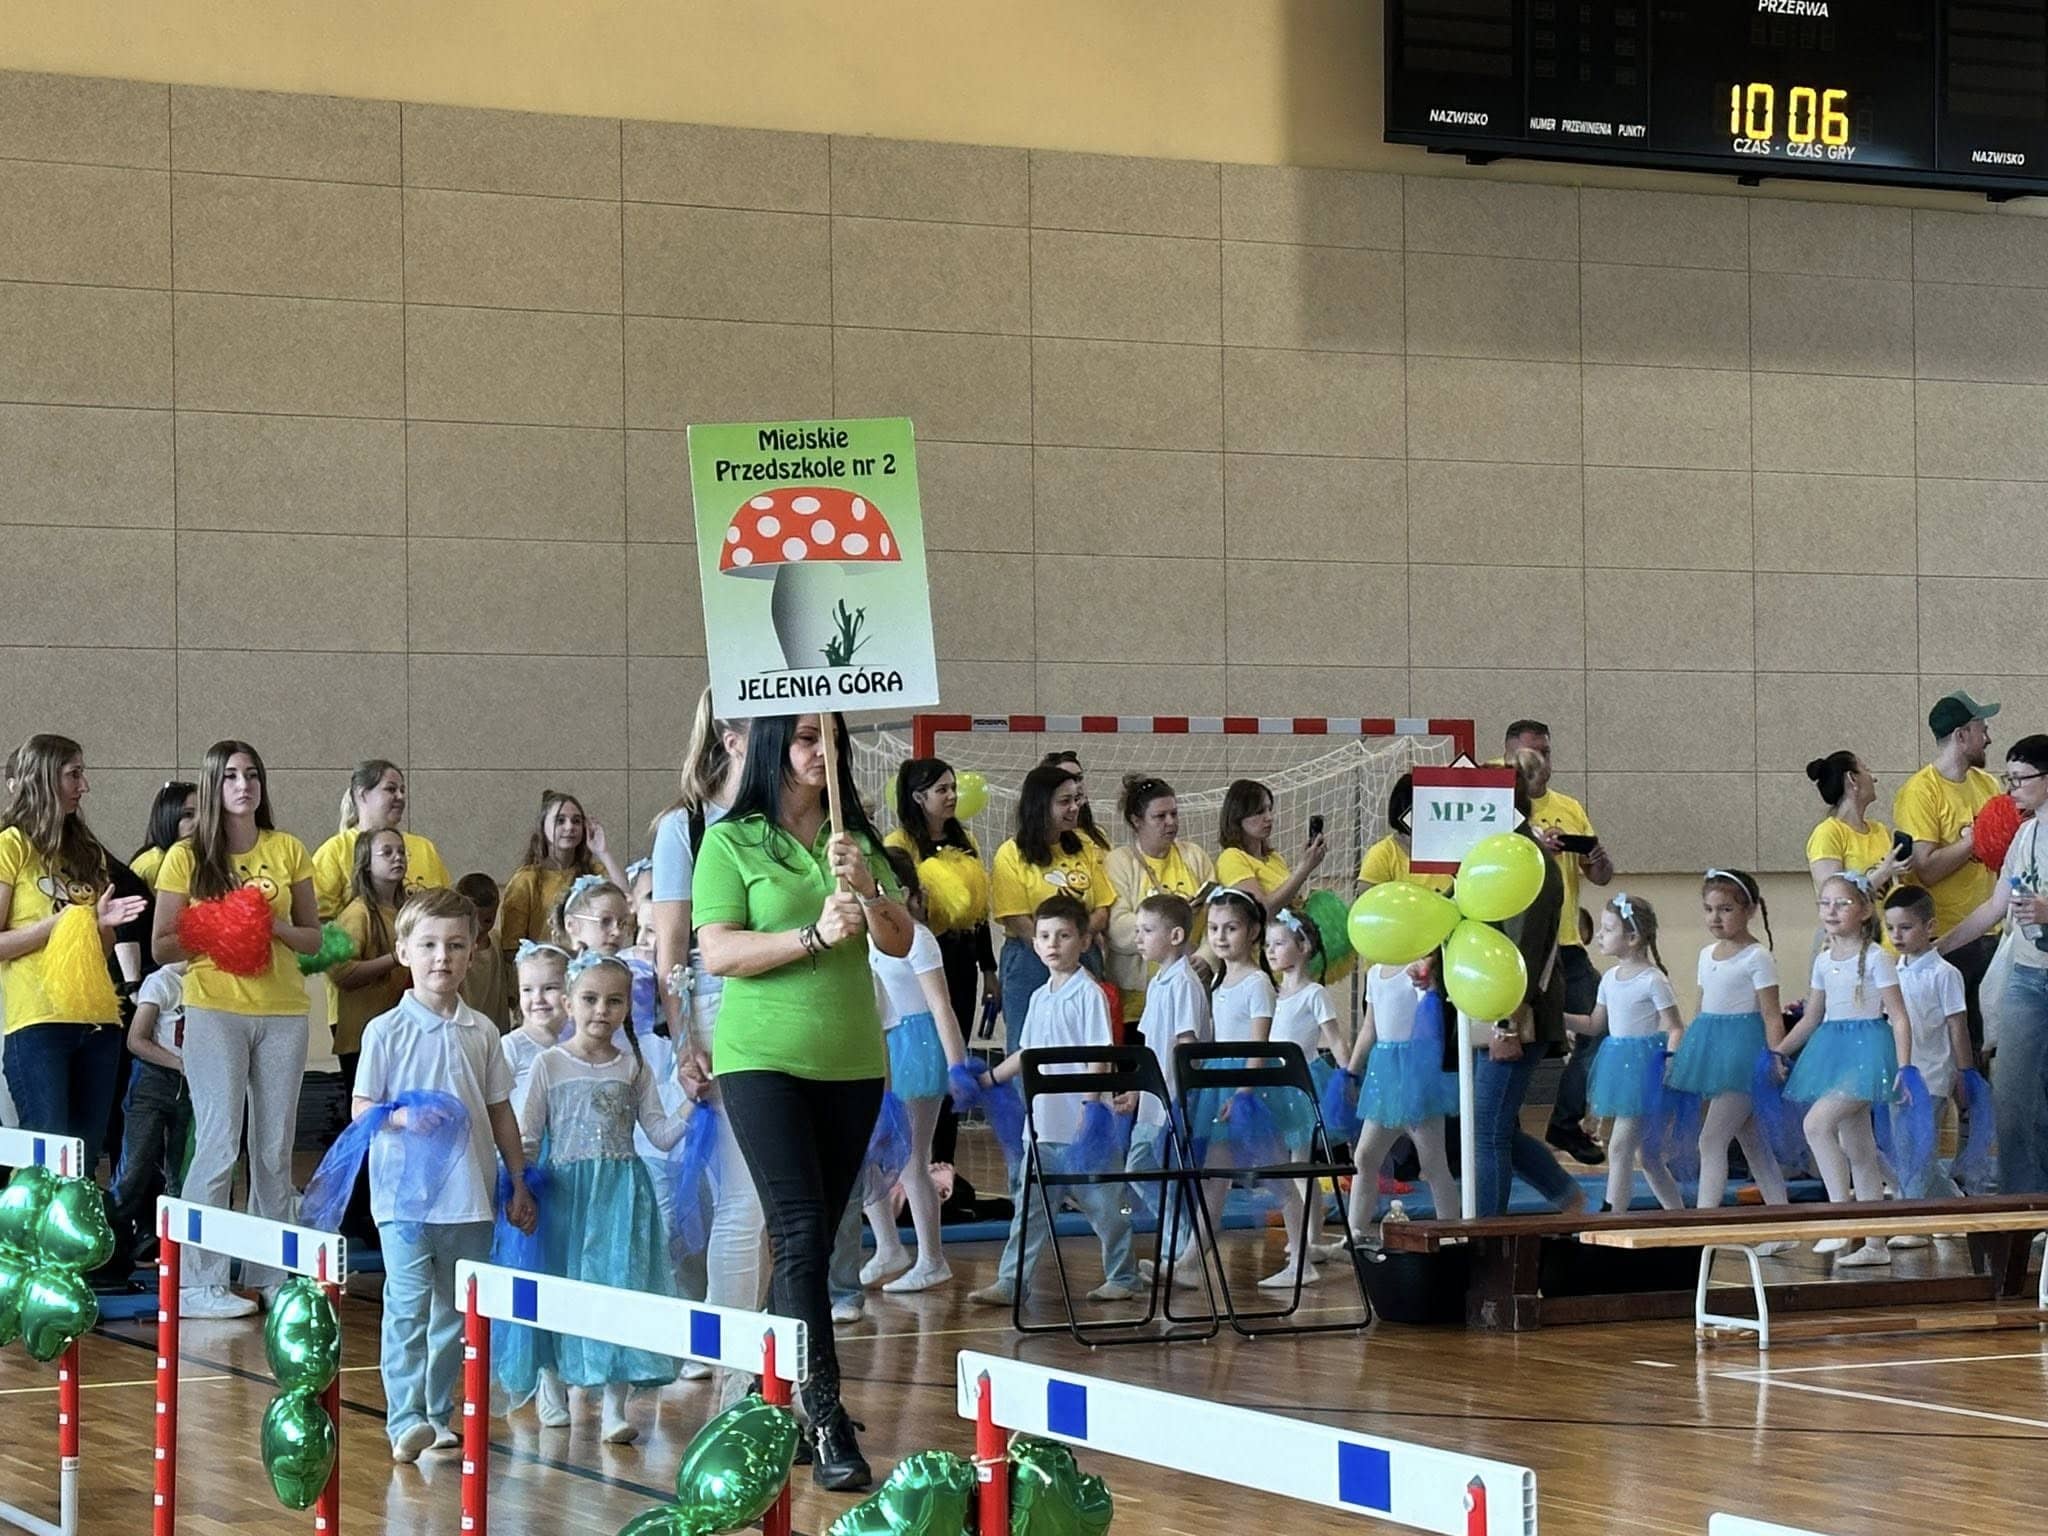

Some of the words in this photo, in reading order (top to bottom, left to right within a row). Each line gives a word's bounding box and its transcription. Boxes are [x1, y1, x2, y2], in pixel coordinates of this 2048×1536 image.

[1758, 0, 1829, 17] PRZERWA
[1429, 109, 1489, 126] NAZWISKO
[1530, 117, 1556, 131] NUMER
[1618, 124, 1646, 137] PUNKTY
[1733, 139, 1771, 154] CZAS
[1786, 143, 1823, 158] CZAS
[1827, 145, 1856, 160] GRY
[1972, 151, 2025, 165] NAZWISKO
[758, 427, 849, 451] Miejskie
[716, 456, 846, 482] Przedszkole
[853, 457, 876, 476] nr
[883, 454, 897, 475] 2
[738, 675, 832, 701] JELENIA
[838, 667, 904, 695] GÓRA
[1429, 802, 1474, 822] MP
[1480, 803, 1496, 822] 2
